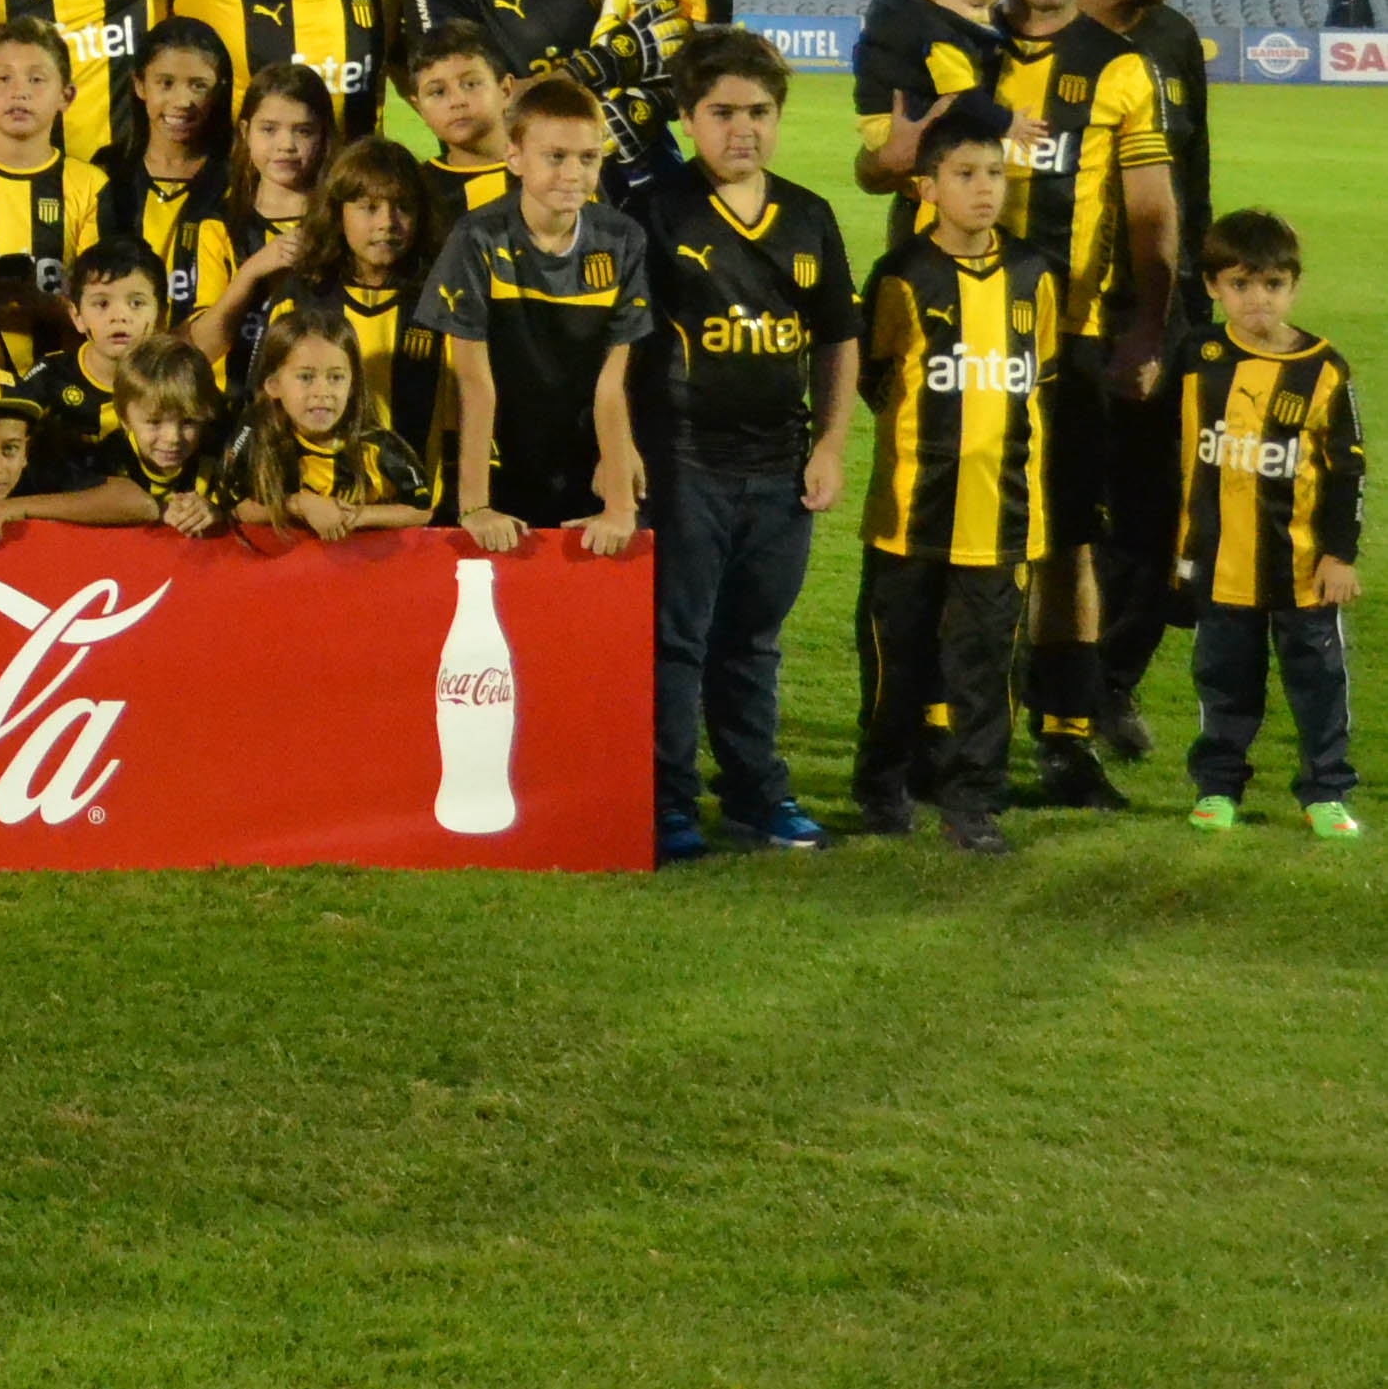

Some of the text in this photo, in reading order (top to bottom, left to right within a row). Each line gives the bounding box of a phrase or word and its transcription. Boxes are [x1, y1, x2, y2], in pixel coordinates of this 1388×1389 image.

[59, 15, 134, 63] ntel
[762, 28, 840, 58] EDITEL
[1329, 41, 1387, 73] SA
[926, 343, 1035, 394] antel
[1197, 420, 1299, 478] antel
[437, 666, 512, 707] Coca-Cola
